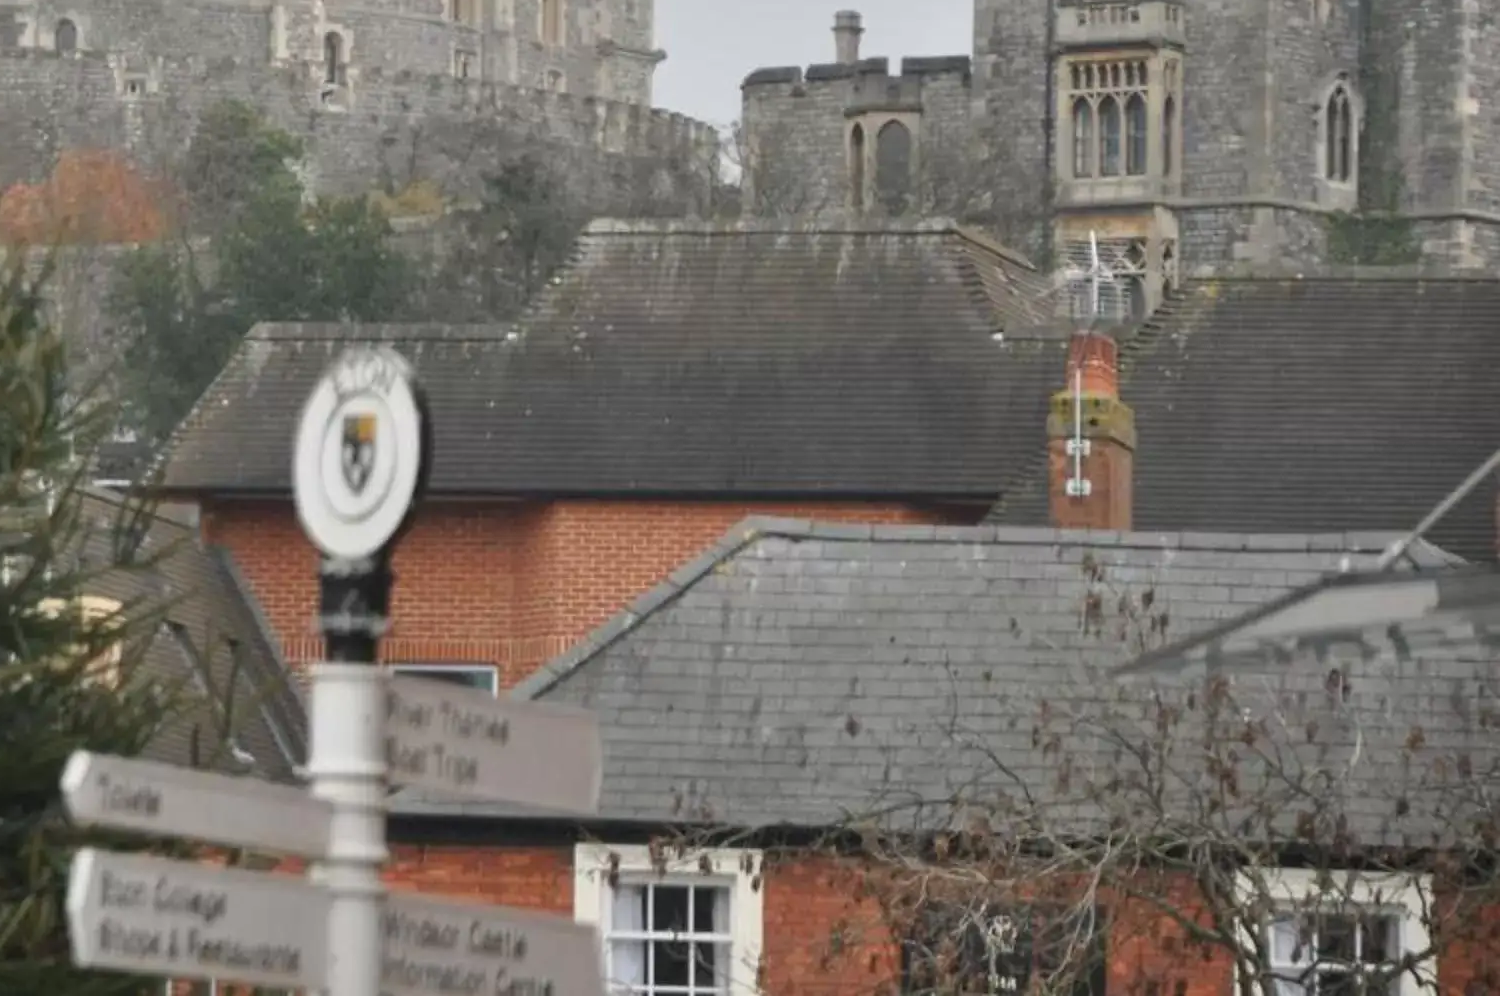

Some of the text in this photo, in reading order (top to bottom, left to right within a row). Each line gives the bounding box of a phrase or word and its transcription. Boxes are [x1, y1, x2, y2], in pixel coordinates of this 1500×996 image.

[440, 699, 510, 746] Thames
[384, 909, 528, 961] Windsor Castle
